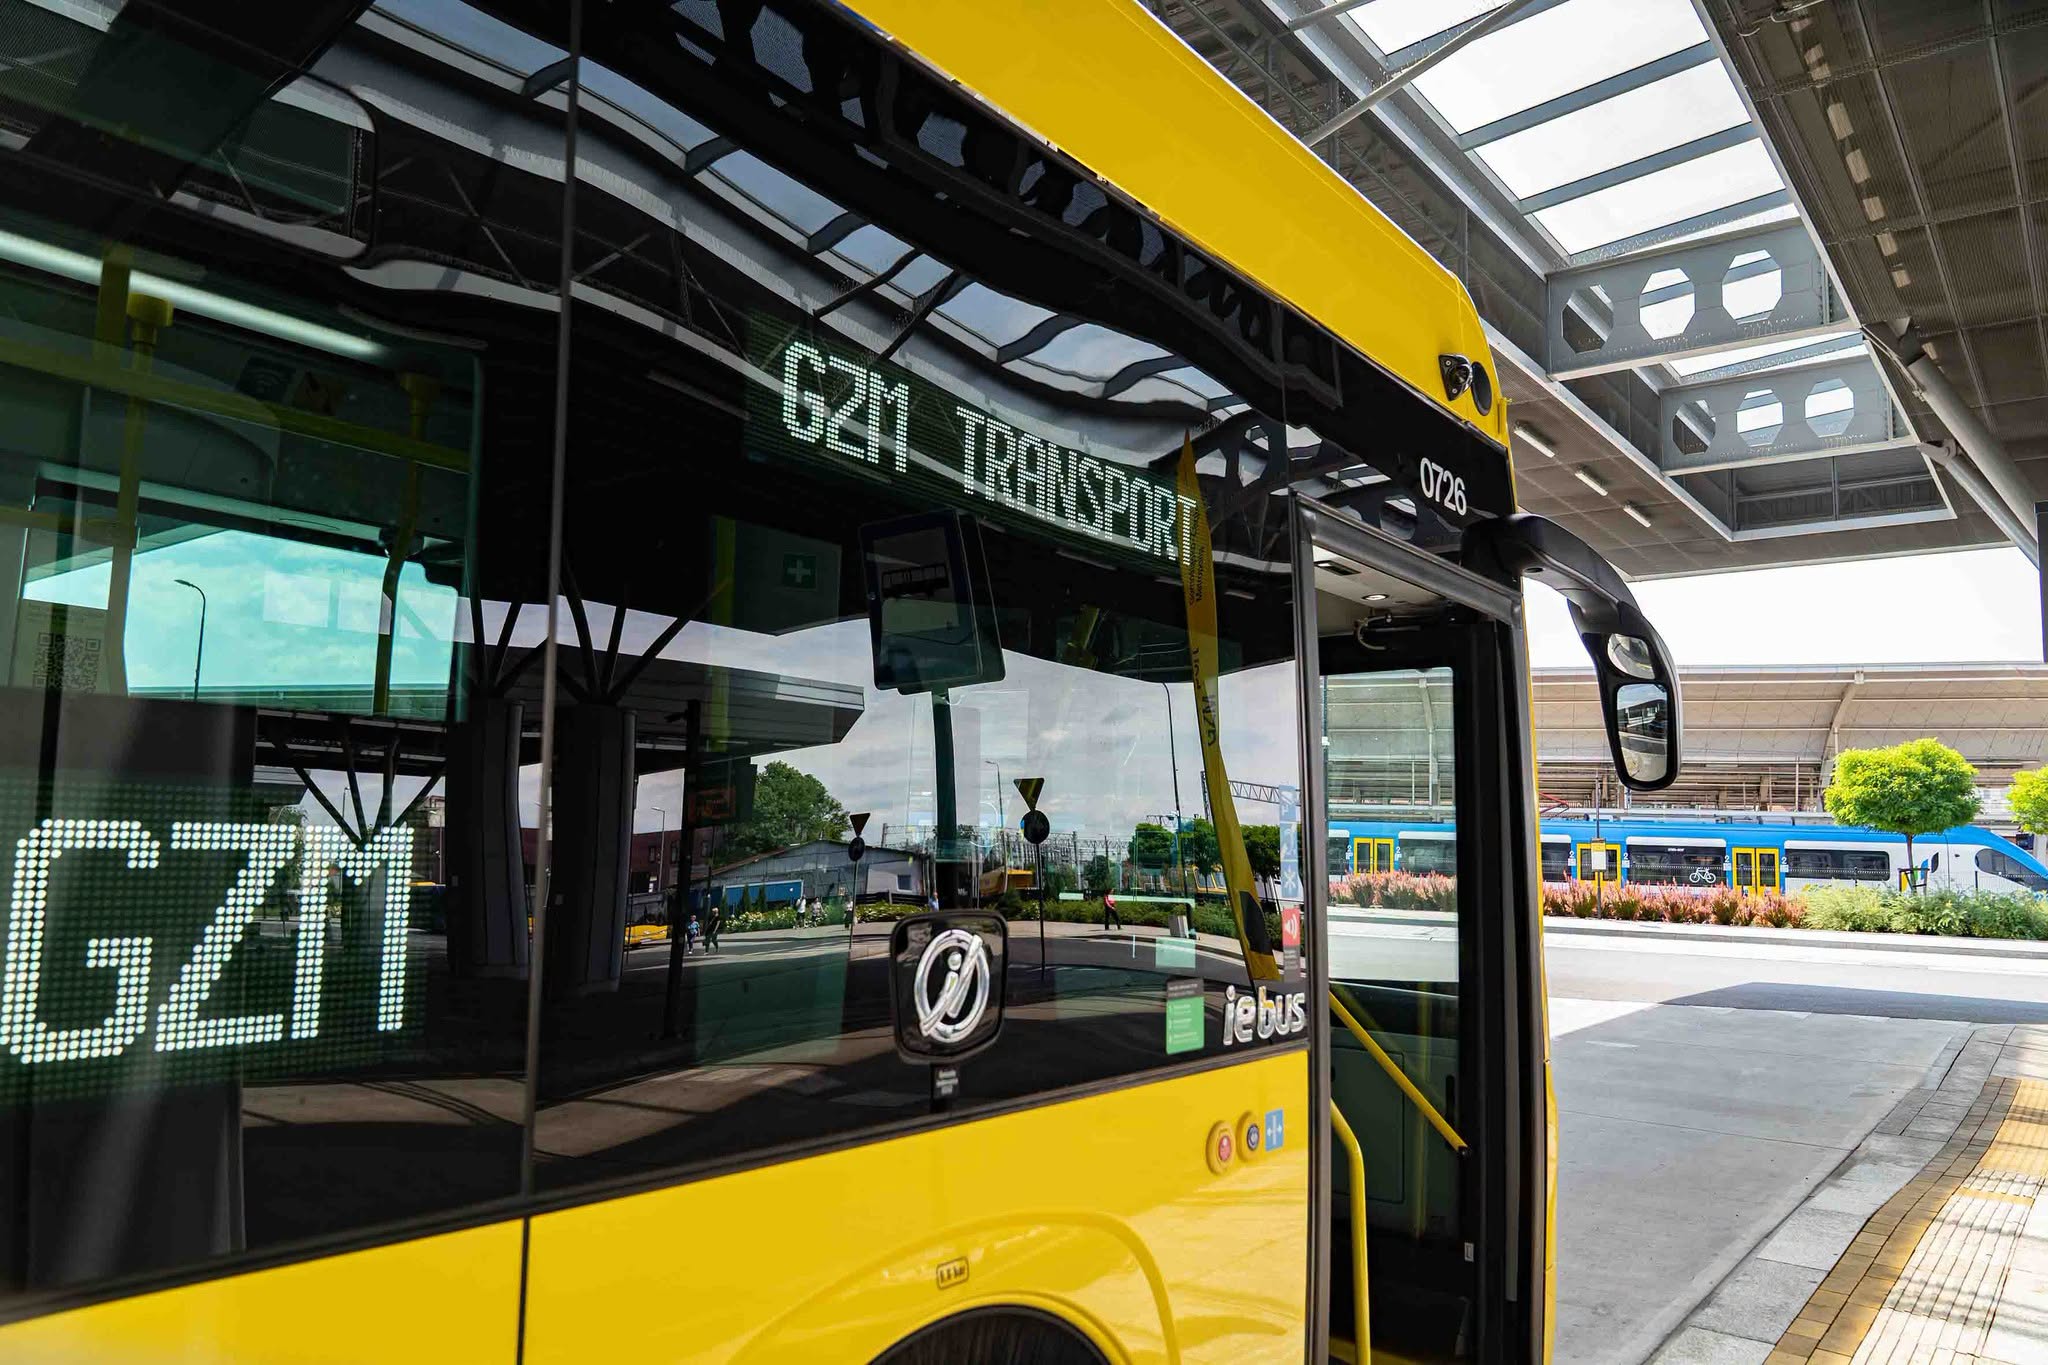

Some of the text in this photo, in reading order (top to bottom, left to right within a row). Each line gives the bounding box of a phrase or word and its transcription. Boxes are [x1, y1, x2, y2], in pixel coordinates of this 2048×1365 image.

[782, 341, 909, 473] GZM
[957, 405, 1196, 566] TRANSPORT
[1420, 457, 1467, 516] 0726
[1623, 852, 1629, 860] 2
[1724, 855, 1730, 863] 2
[1781, 856, 1787, 864] 2
[0, 819, 414, 1064] GZM
[1223, 984, 1305, 1046] iebus
